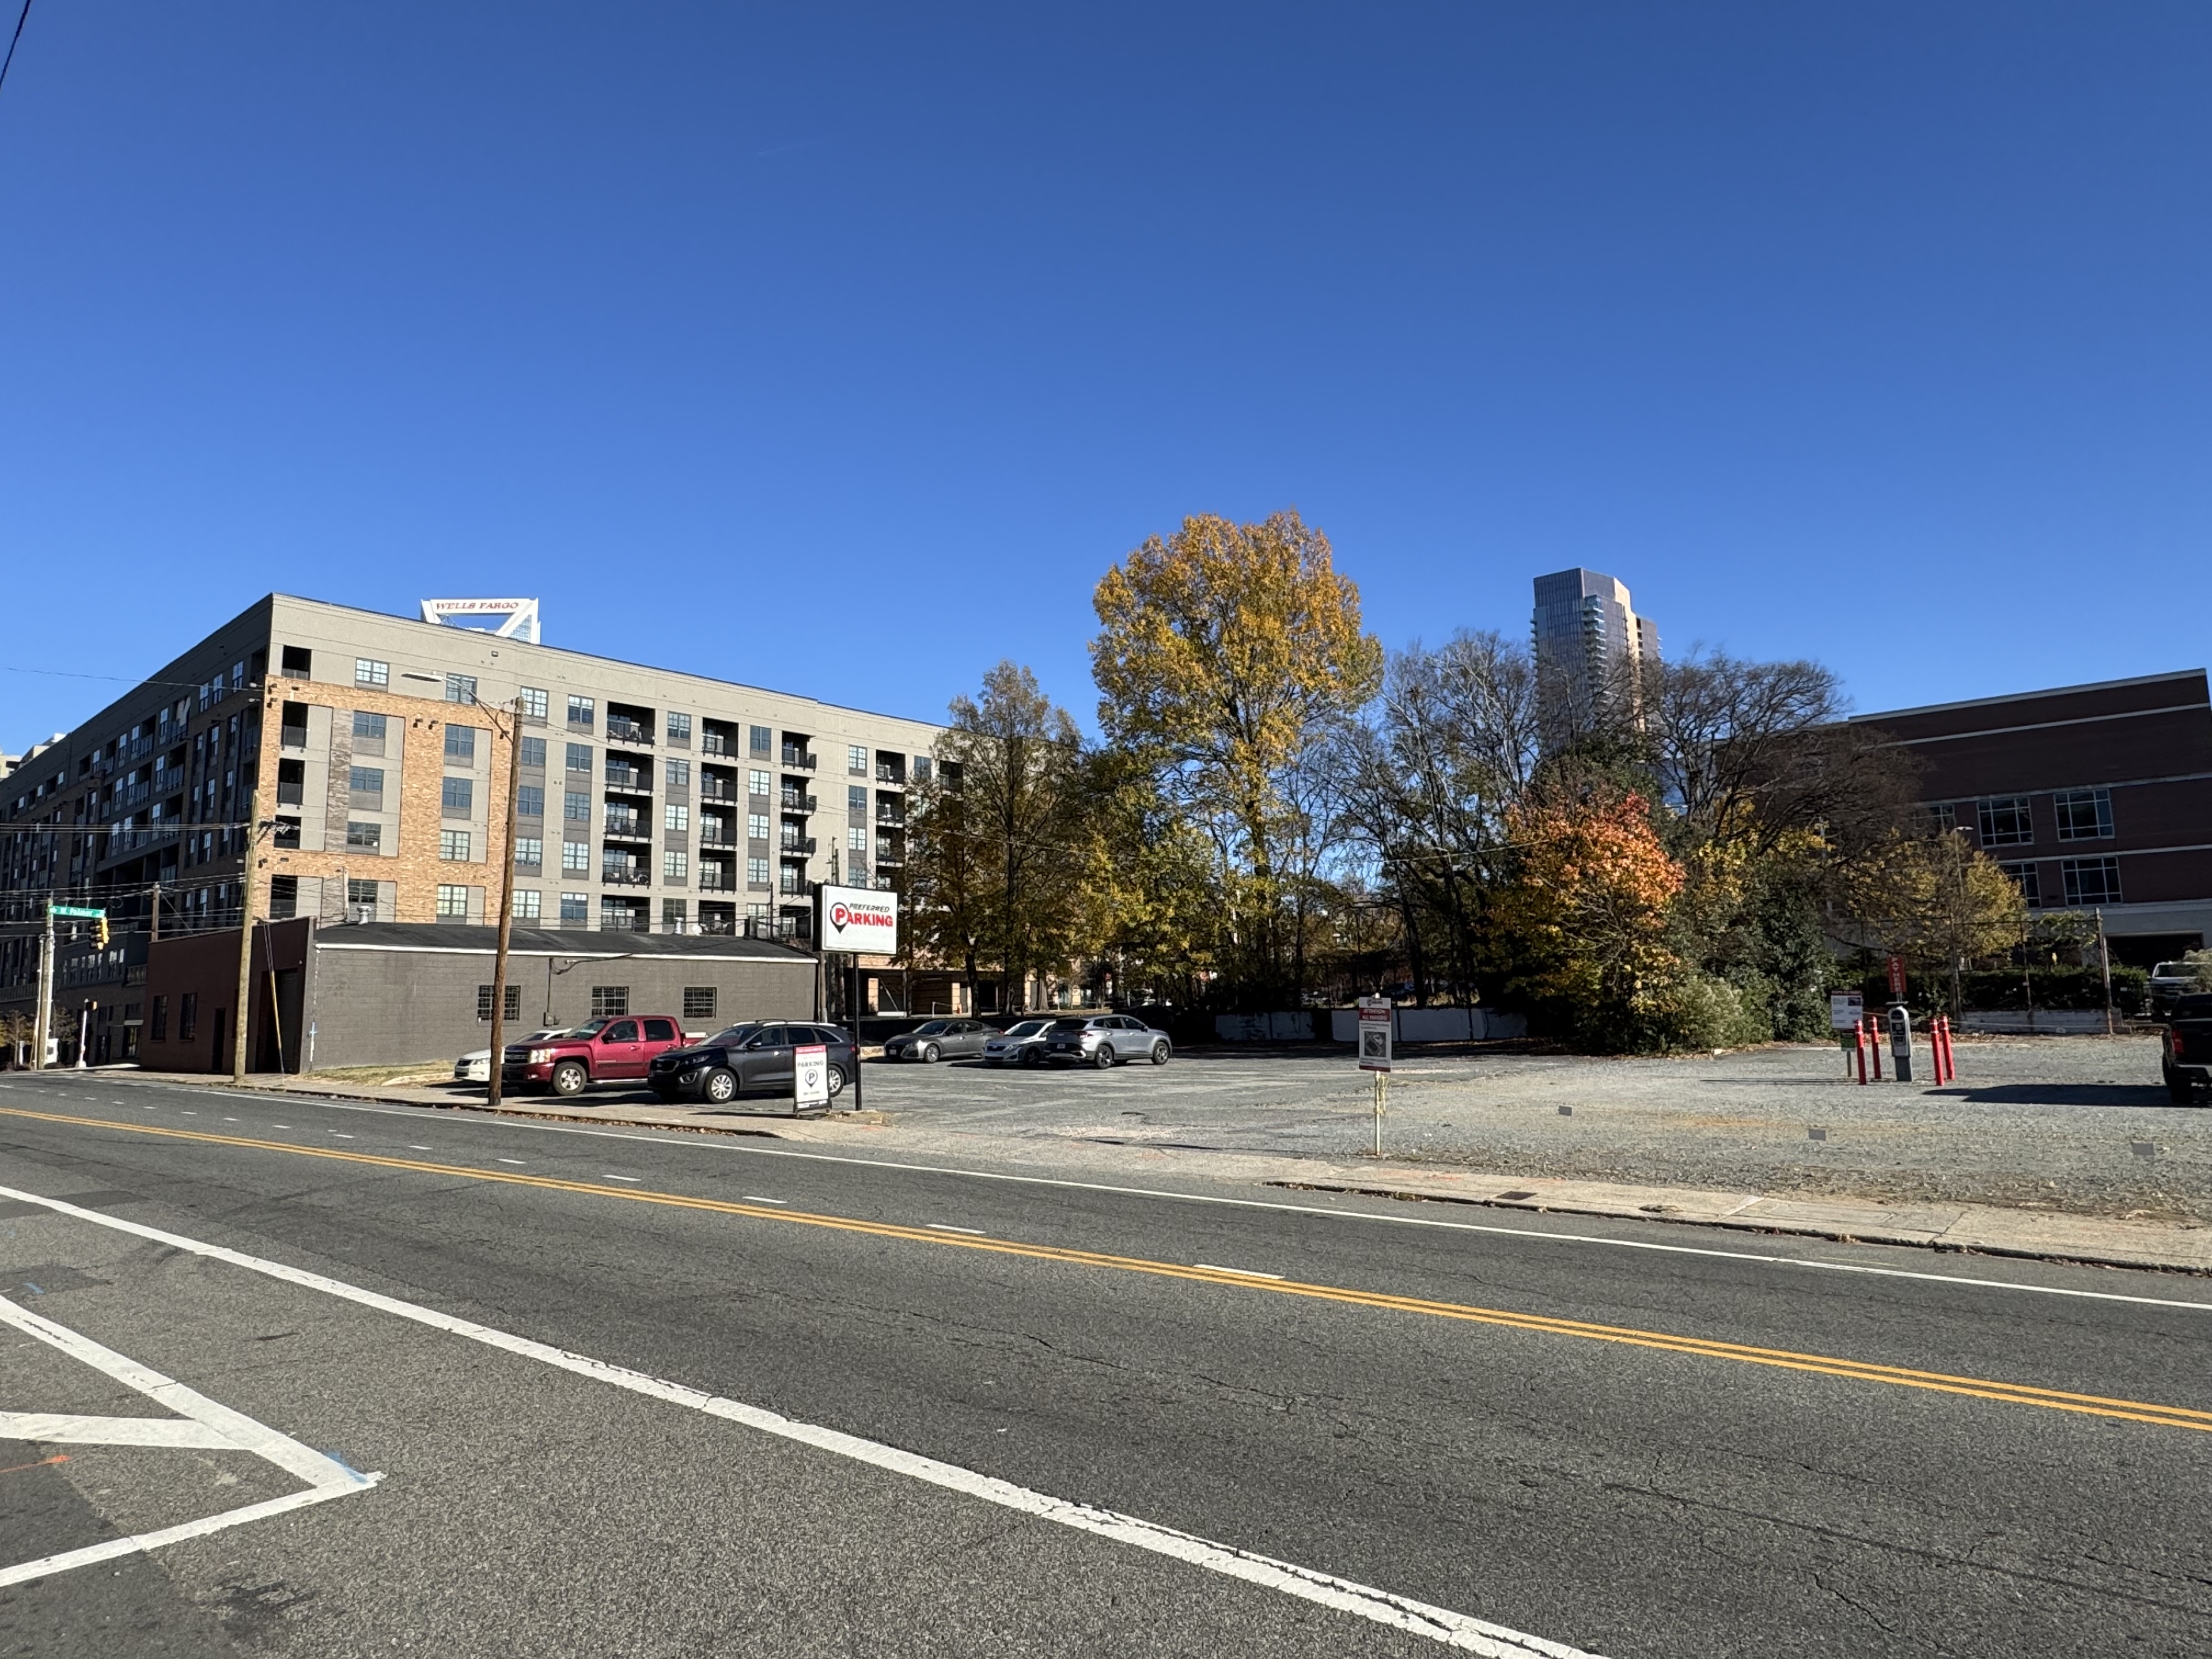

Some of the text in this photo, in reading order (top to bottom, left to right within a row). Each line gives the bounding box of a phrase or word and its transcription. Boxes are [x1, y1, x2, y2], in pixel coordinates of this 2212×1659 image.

[849, 903, 890, 912] PREFERRED
[835, 908, 893, 927] PARKING
[809, 1073, 815, 1082] P
